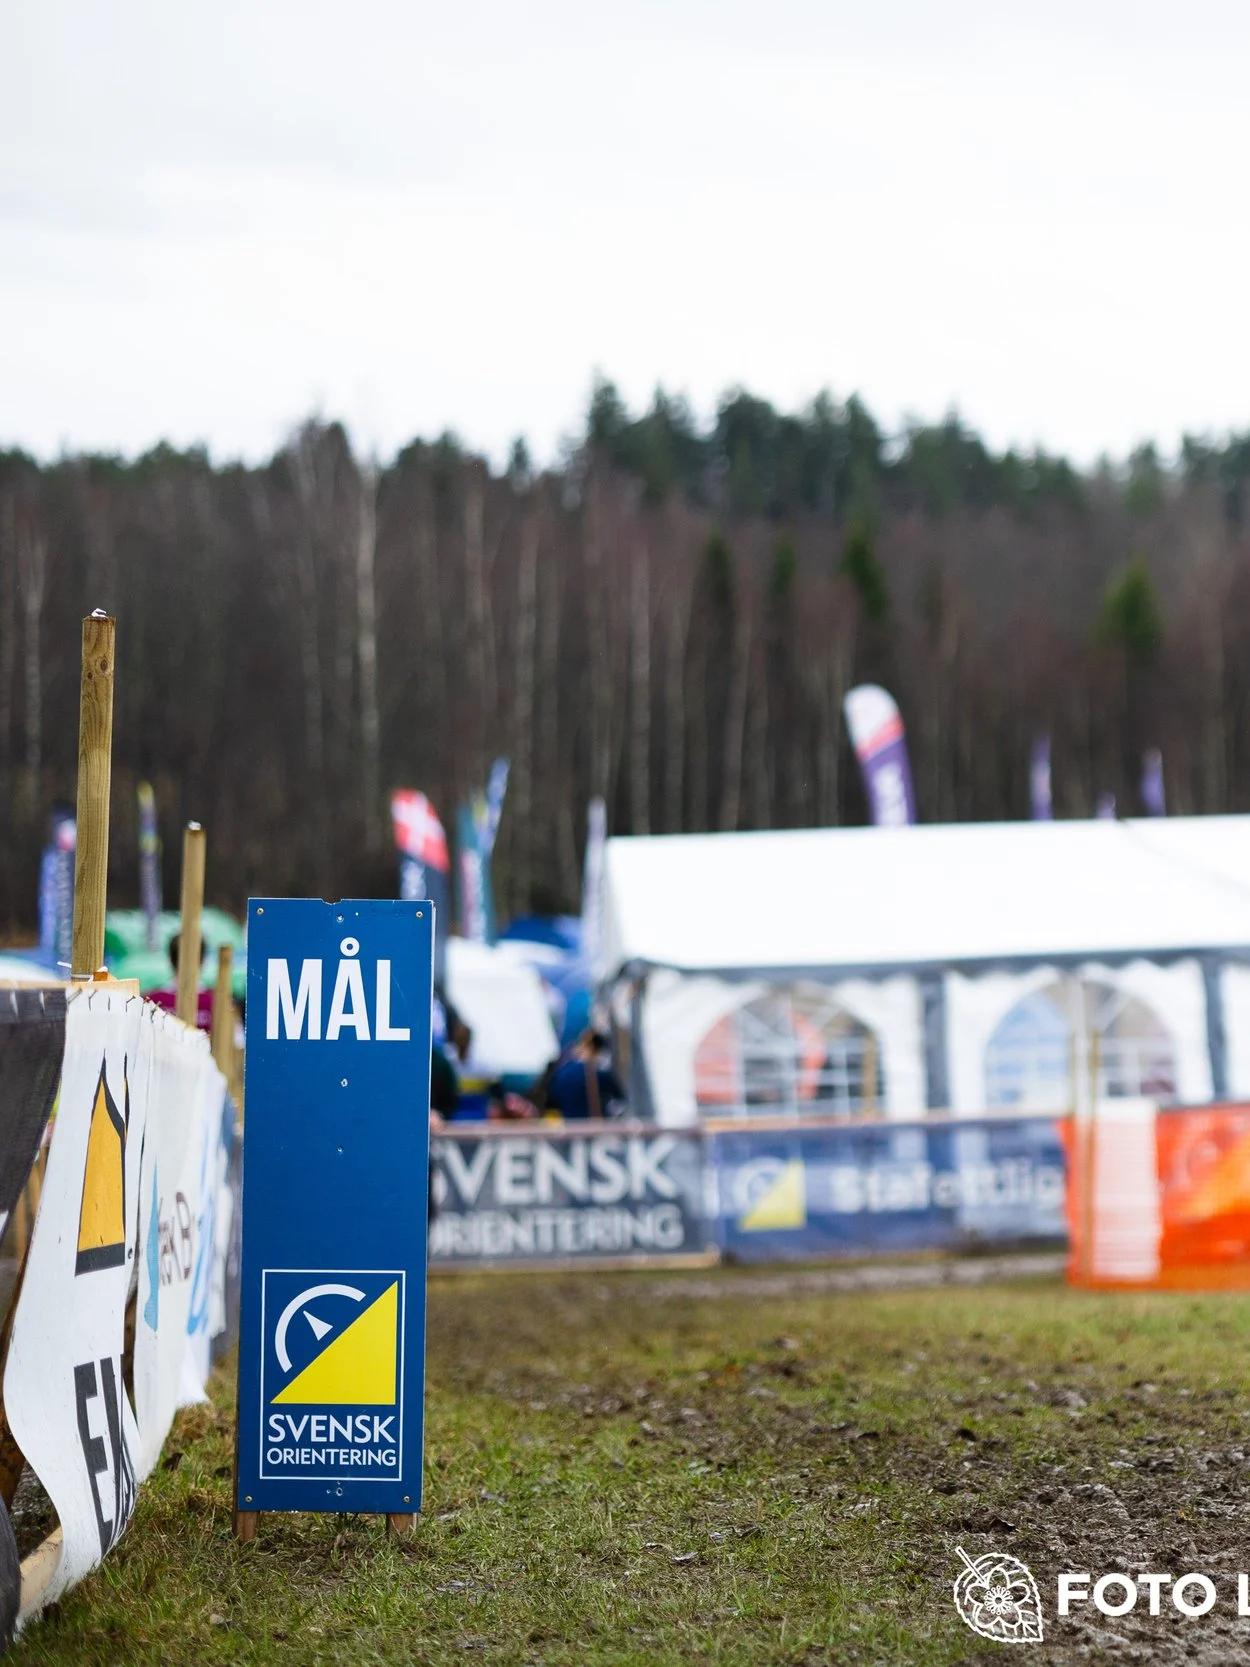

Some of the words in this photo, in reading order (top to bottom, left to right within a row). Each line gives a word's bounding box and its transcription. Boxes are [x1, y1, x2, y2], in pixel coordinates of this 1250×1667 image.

[266, 937, 411, 1041] MÅL
[268, 1414, 396, 1444] SVENSK
[266, 1447, 397, 1466] ORIENTERING
